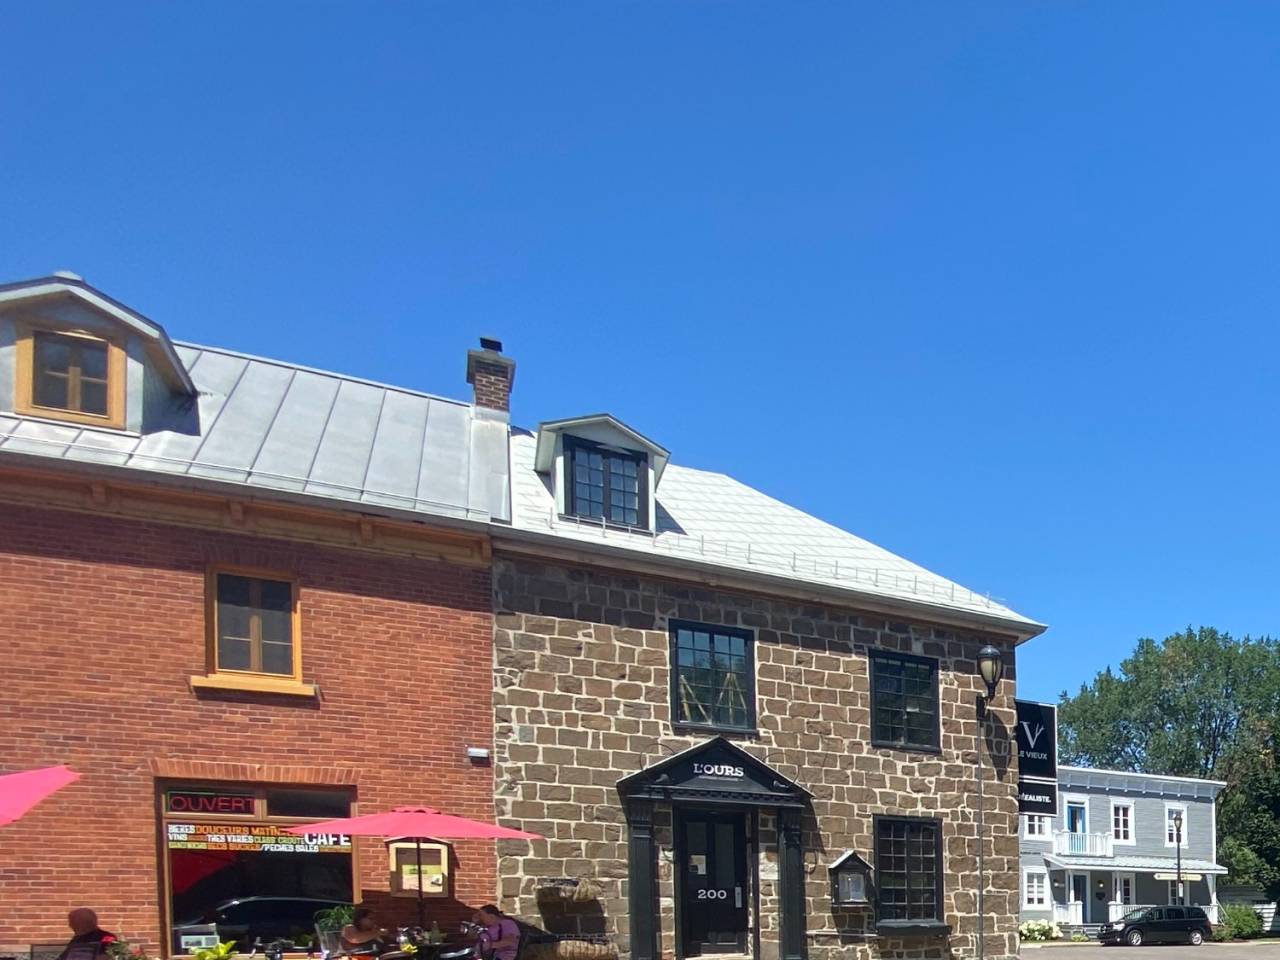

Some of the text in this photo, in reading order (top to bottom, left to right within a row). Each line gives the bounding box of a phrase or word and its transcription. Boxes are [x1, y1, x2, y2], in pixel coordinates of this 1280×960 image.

[1025, 751, 1048, 760] VIEUX
[693, 763, 745, 778] L'OURS
[170, 796, 256, 813] OUVERT
[196, 825, 249, 835] DOUCEURS
[697, 888, 727, 900] 200
